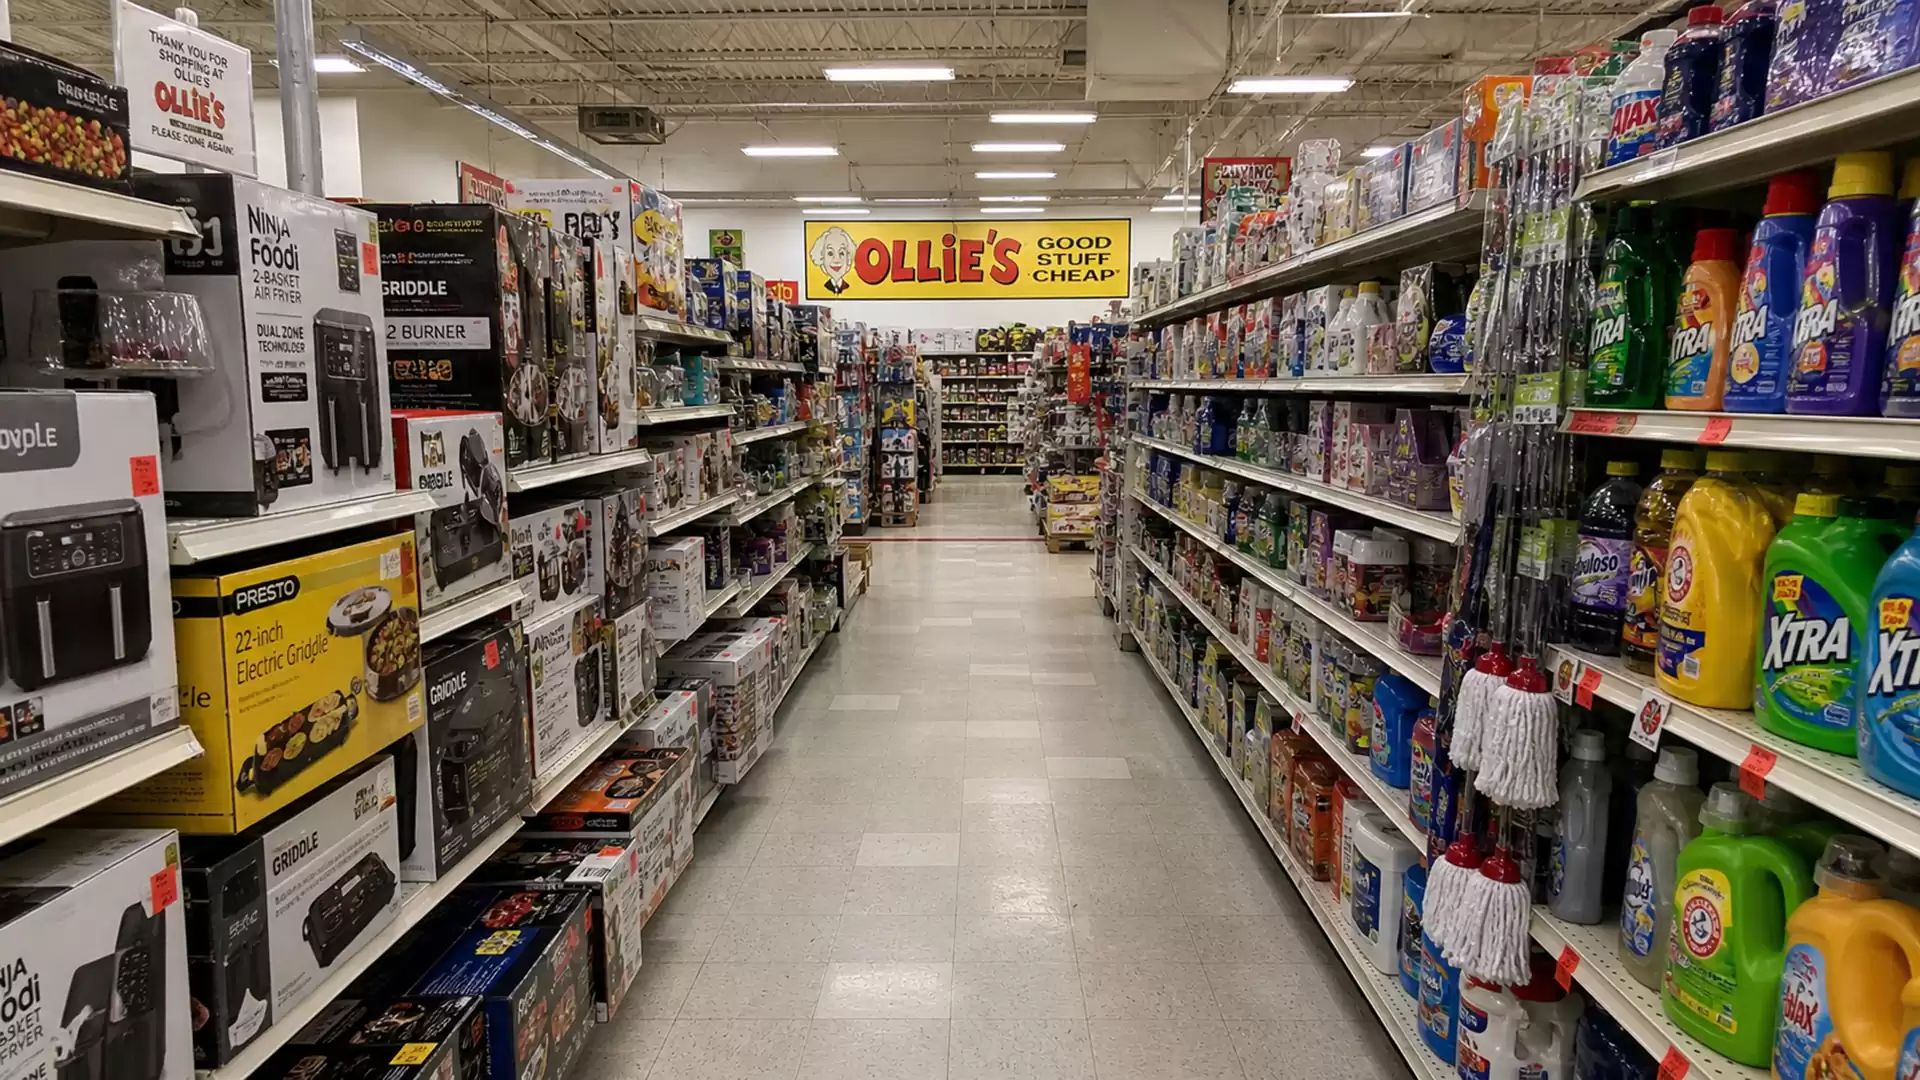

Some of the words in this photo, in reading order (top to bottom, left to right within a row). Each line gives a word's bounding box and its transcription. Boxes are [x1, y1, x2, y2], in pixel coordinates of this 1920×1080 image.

[149, 29, 185, 53] THANK
[187, 45, 207, 61] YOU
[210, 52, 228, 68] FOR
[212, 68, 224, 80] AT
[251, 238, 300, 271] Foodi
[1037, 236, 1112, 250] GOOD
[1037, 253, 1111, 266] STUFF
[253, 269, 300, 287] 2-BASKET
[381, 280, 448, 296] GRIDDLE
[254, 286, 271, 301] AIR
[257, 324, 280, 337] DUAL
[282, 325, 304, 339] ZONE
[386, 324, 397, 340] 2
[402, 324, 467, 340] BURNER
[236, 579, 296, 611] PRESTO
[235, 619, 284, 654] 22-inch
[1762, 611, 1850, 672] XTRA
[236, 650, 284, 686] Electric
[286, 633, 329, 666] Griddle
[430, 670, 468, 706] GRIDDLE
[272, 831, 319, 877] GRIDDLE
